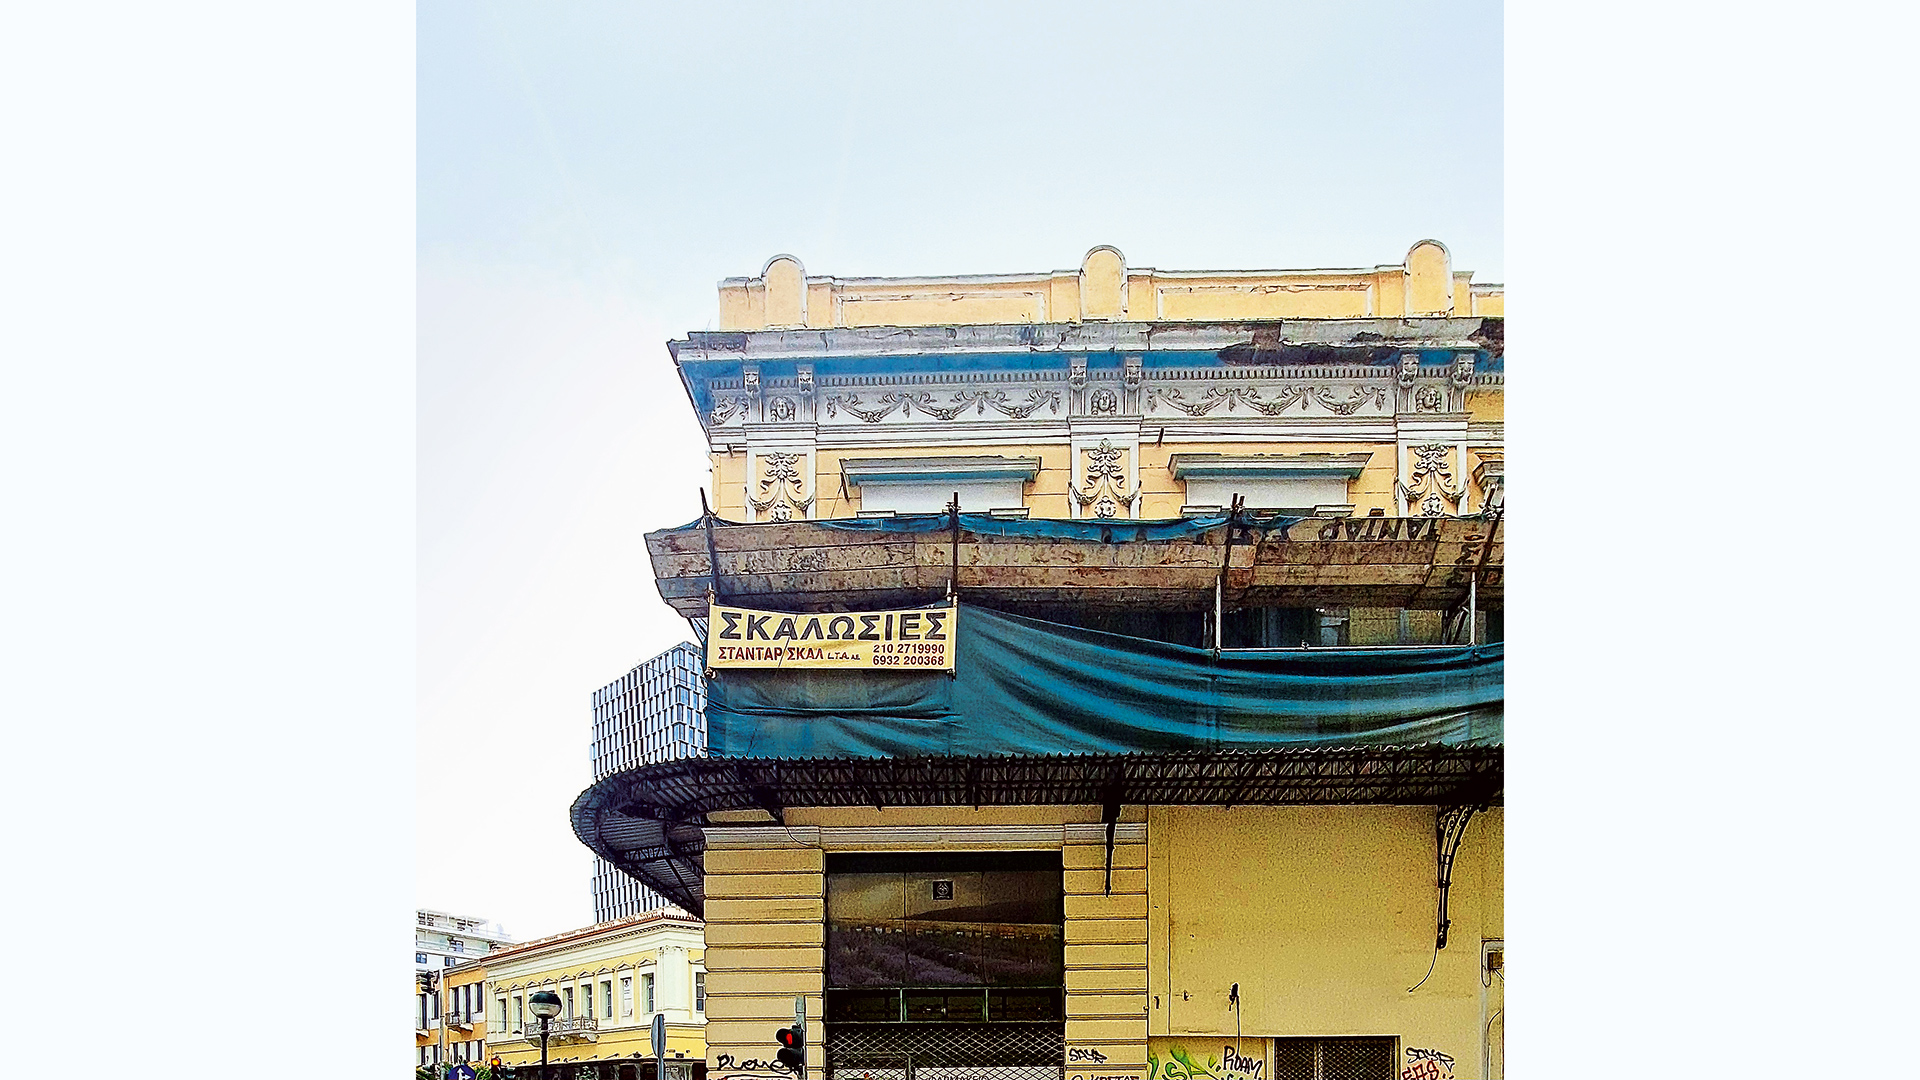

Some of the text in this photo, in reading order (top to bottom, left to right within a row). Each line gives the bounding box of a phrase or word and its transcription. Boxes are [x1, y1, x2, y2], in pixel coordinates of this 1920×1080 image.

[719, 611, 947, 641] ΣΚΑΛΩΣΙΕΣ
[718, 646, 783, 661] ΣΤΑΝΤΑΡ
[786, 647, 824, 661] ΣΚΑΛ
[873, 644, 945, 655] 210 2719990
[872, 655, 945, 666] 6932 200368
